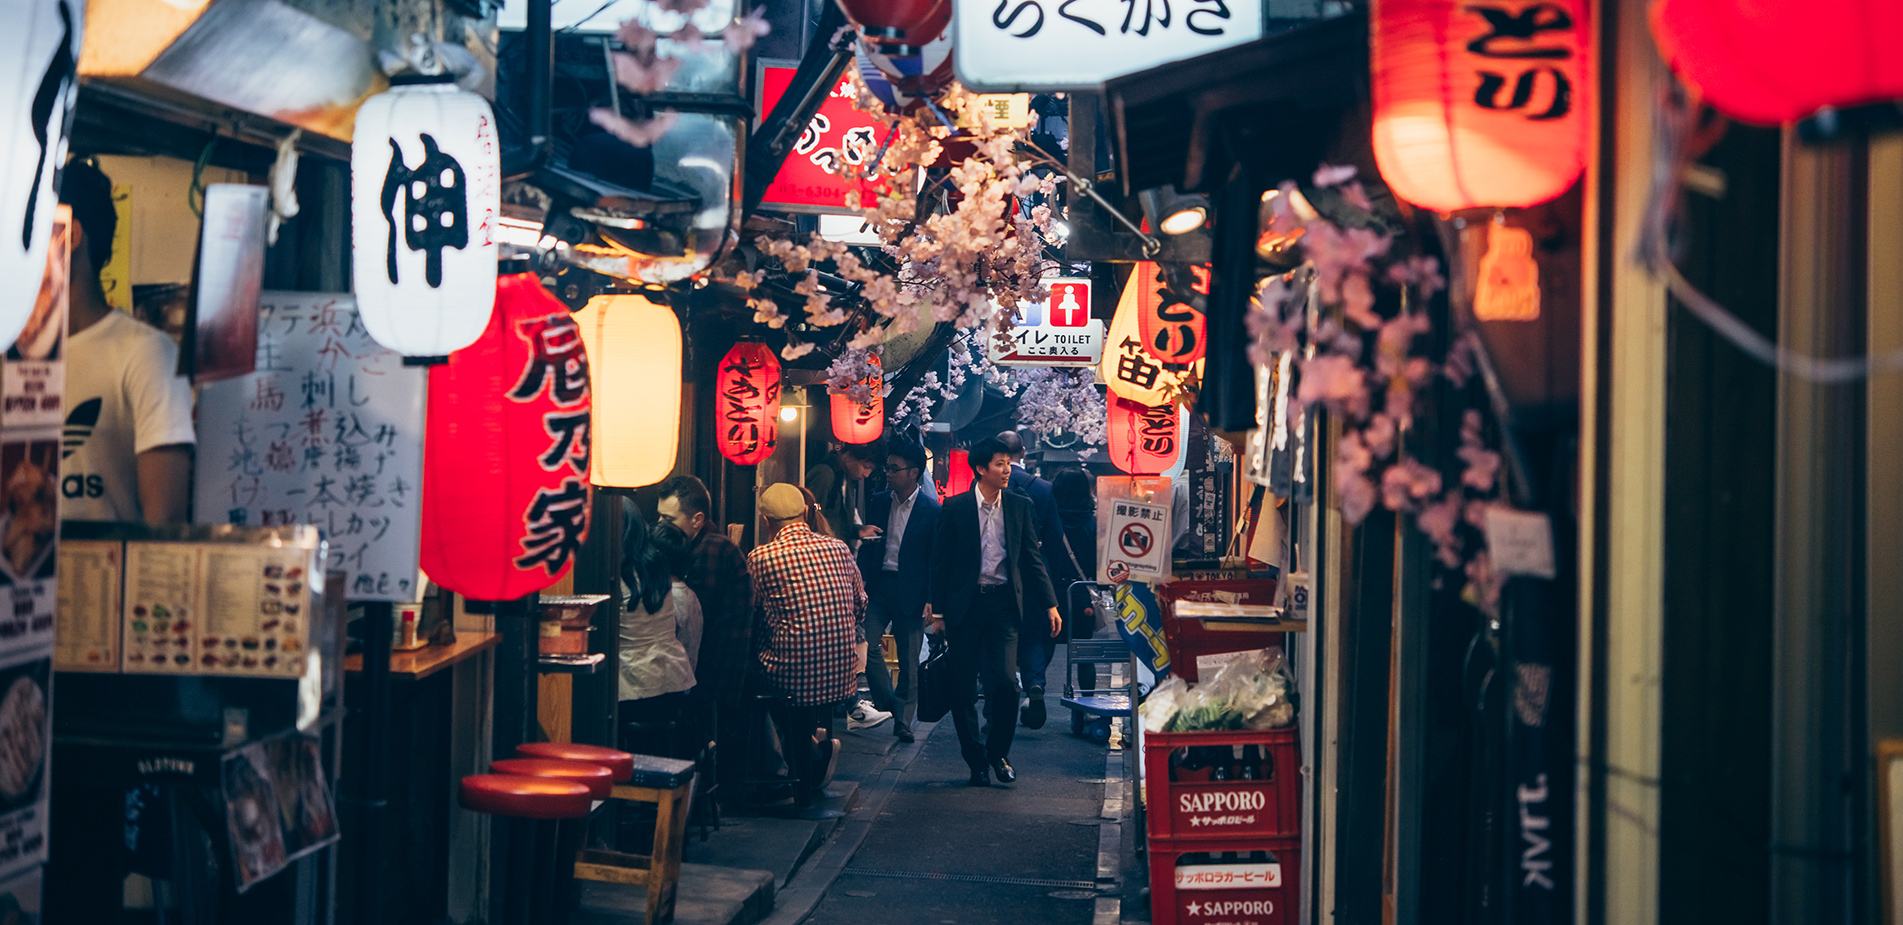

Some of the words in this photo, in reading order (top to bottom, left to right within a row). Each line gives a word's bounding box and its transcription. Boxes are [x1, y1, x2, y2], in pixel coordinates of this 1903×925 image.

[380, 132, 470, 289] 伸
[1054, 335, 1091, 344] TOILET
[1028, 346, 1079, 355] ここ奥入る
[1116, 505, 1163, 521] 撮影禁止
[1205, 571, 1234, 580] TOKYO
[1180, 790, 1265, 812] SAPPORO
[1176, 871, 1275, 884] サッポロラガービール
[1203, 900, 1274, 916] SAPPORO
